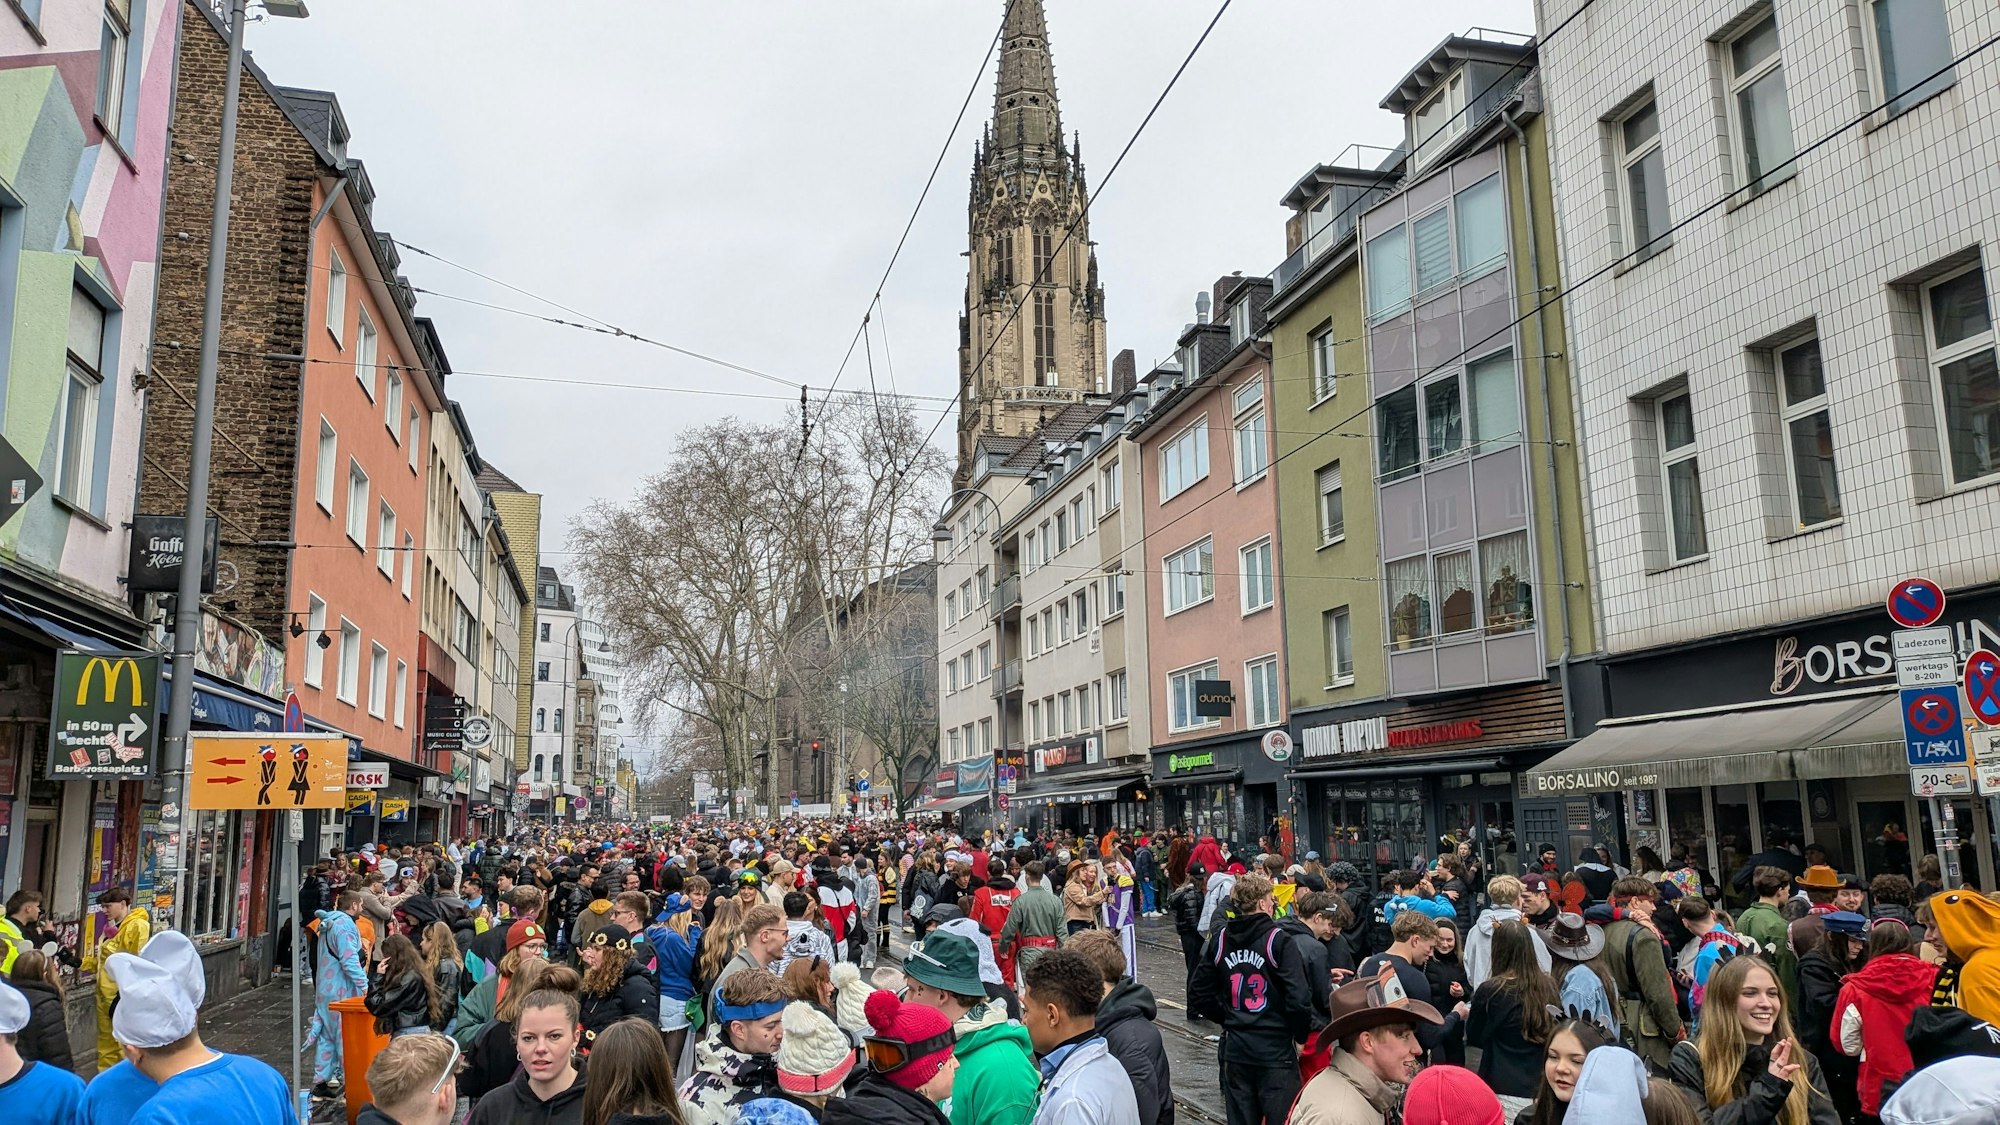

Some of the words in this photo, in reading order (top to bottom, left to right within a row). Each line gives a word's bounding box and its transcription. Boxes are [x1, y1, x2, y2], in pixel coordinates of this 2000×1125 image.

[146, 553, 183, 568] Kölsc
[1897, 639, 1948, 649] Ladezone
[1770, 619, 2000, 695] BORSIN
[1905, 662, 1949, 672] werktags
[1914, 673, 1941, 681] 8-20h
[1199, 694, 1231, 703] duma
[66, 720, 79, 731] in
[82, 721, 100, 731] 50
[101, 723, 113, 731] m
[71, 735, 109, 745] echts
[1302, 725, 1341, 758] NONNA
[1342, 716, 1388, 753] NAPOLI
[1412, 727, 1439, 747] PASTA
[1439, 720, 1483, 743] DRINKS
[1912, 740, 1960, 758] TAXI
[997, 757, 1024, 765] MNGO
[55, 765, 141, 773] Barbrossaplatz
[1538, 771, 1619, 790] BORSALINO
[1639, 775, 1658, 785] 1987
[1922, 774, 1957, 786] 20-8
[1224, 949, 1265, 969] ADEBAYO
[1230, 973, 1268, 1012] 13
